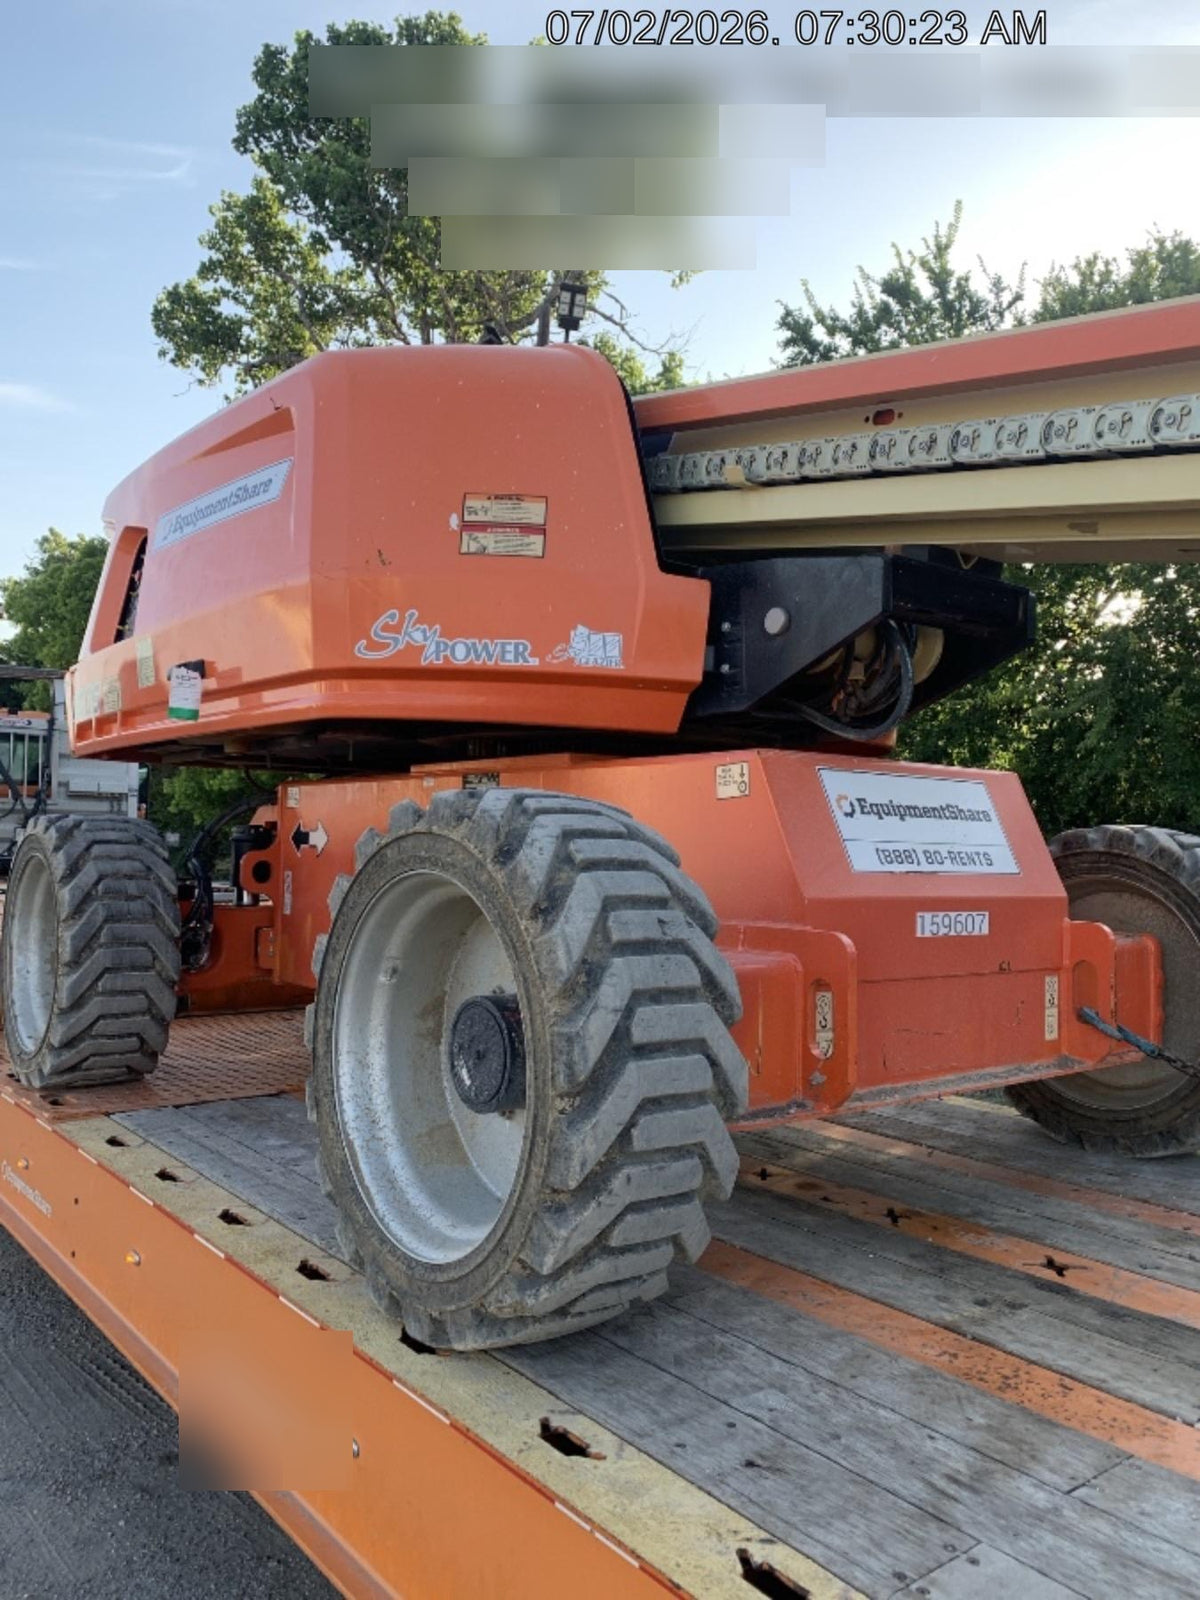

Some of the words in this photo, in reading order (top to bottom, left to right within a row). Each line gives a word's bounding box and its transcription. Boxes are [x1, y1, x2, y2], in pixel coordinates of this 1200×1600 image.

[172, 478, 273, 534] EquipmentShare
[355, 609, 441, 665] Sky
[432, 638, 532, 664] POWER
[856, 797, 992, 823] EquipmentShare
[875, 847, 920, 867] (888)
[922, 849, 994, 867] 80-RENTS
[917, 913, 987, 936] 159607
